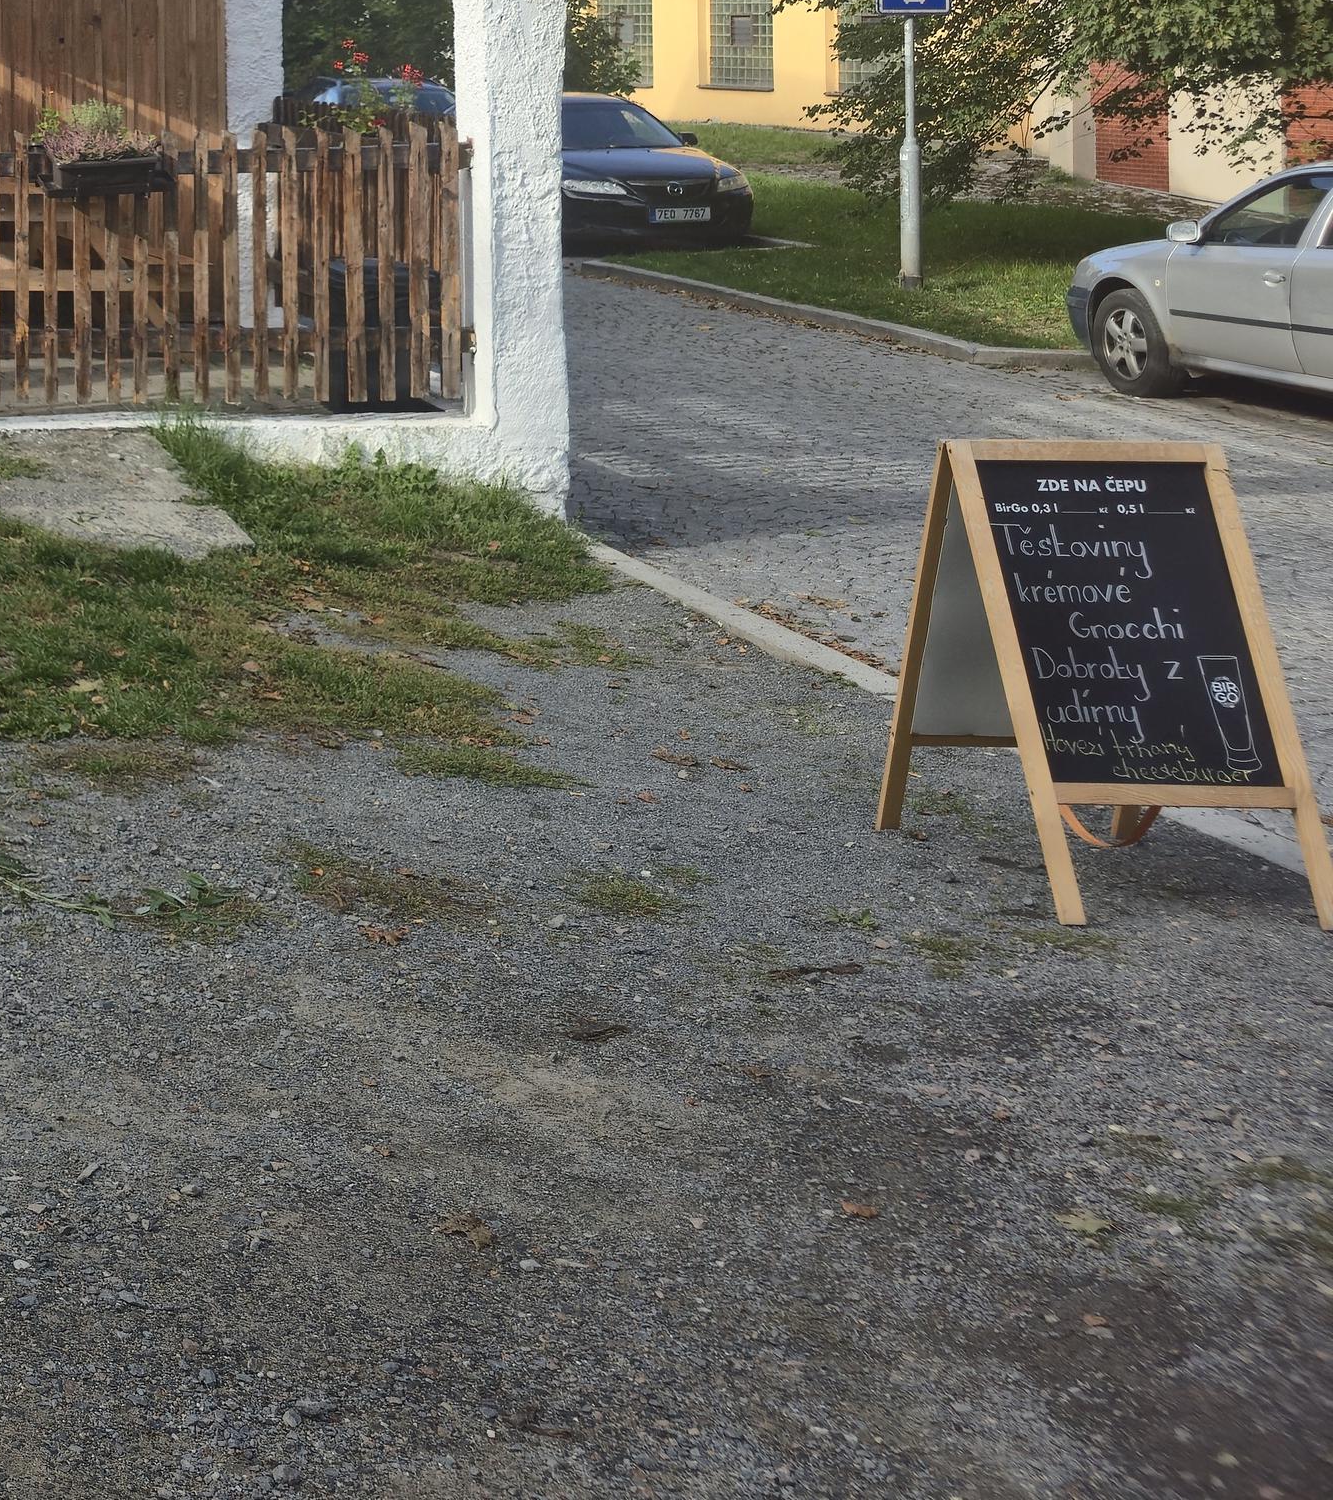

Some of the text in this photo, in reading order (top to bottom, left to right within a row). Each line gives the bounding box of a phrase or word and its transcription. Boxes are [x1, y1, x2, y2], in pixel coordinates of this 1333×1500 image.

[1037, 476, 1147, 493] ZDE NA ČEPU
[995, 503, 1029, 513] BirGo
[1031, 504, 1051, 514] 0,3
[1117, 504, 1137, 515] 0,5
[990, 523, 1153, 579] Těstoviny
[1013, 567, 1132, 603] krémové
[1069, 607, 1184, 639] Gnocchi
[1031, 646, 1151, 701] Dobroty
[1211, 681, 1238, 692] BIR
[1215, 692, 1239, 703] GO
[1047, 688, 1145, 744] udírny
